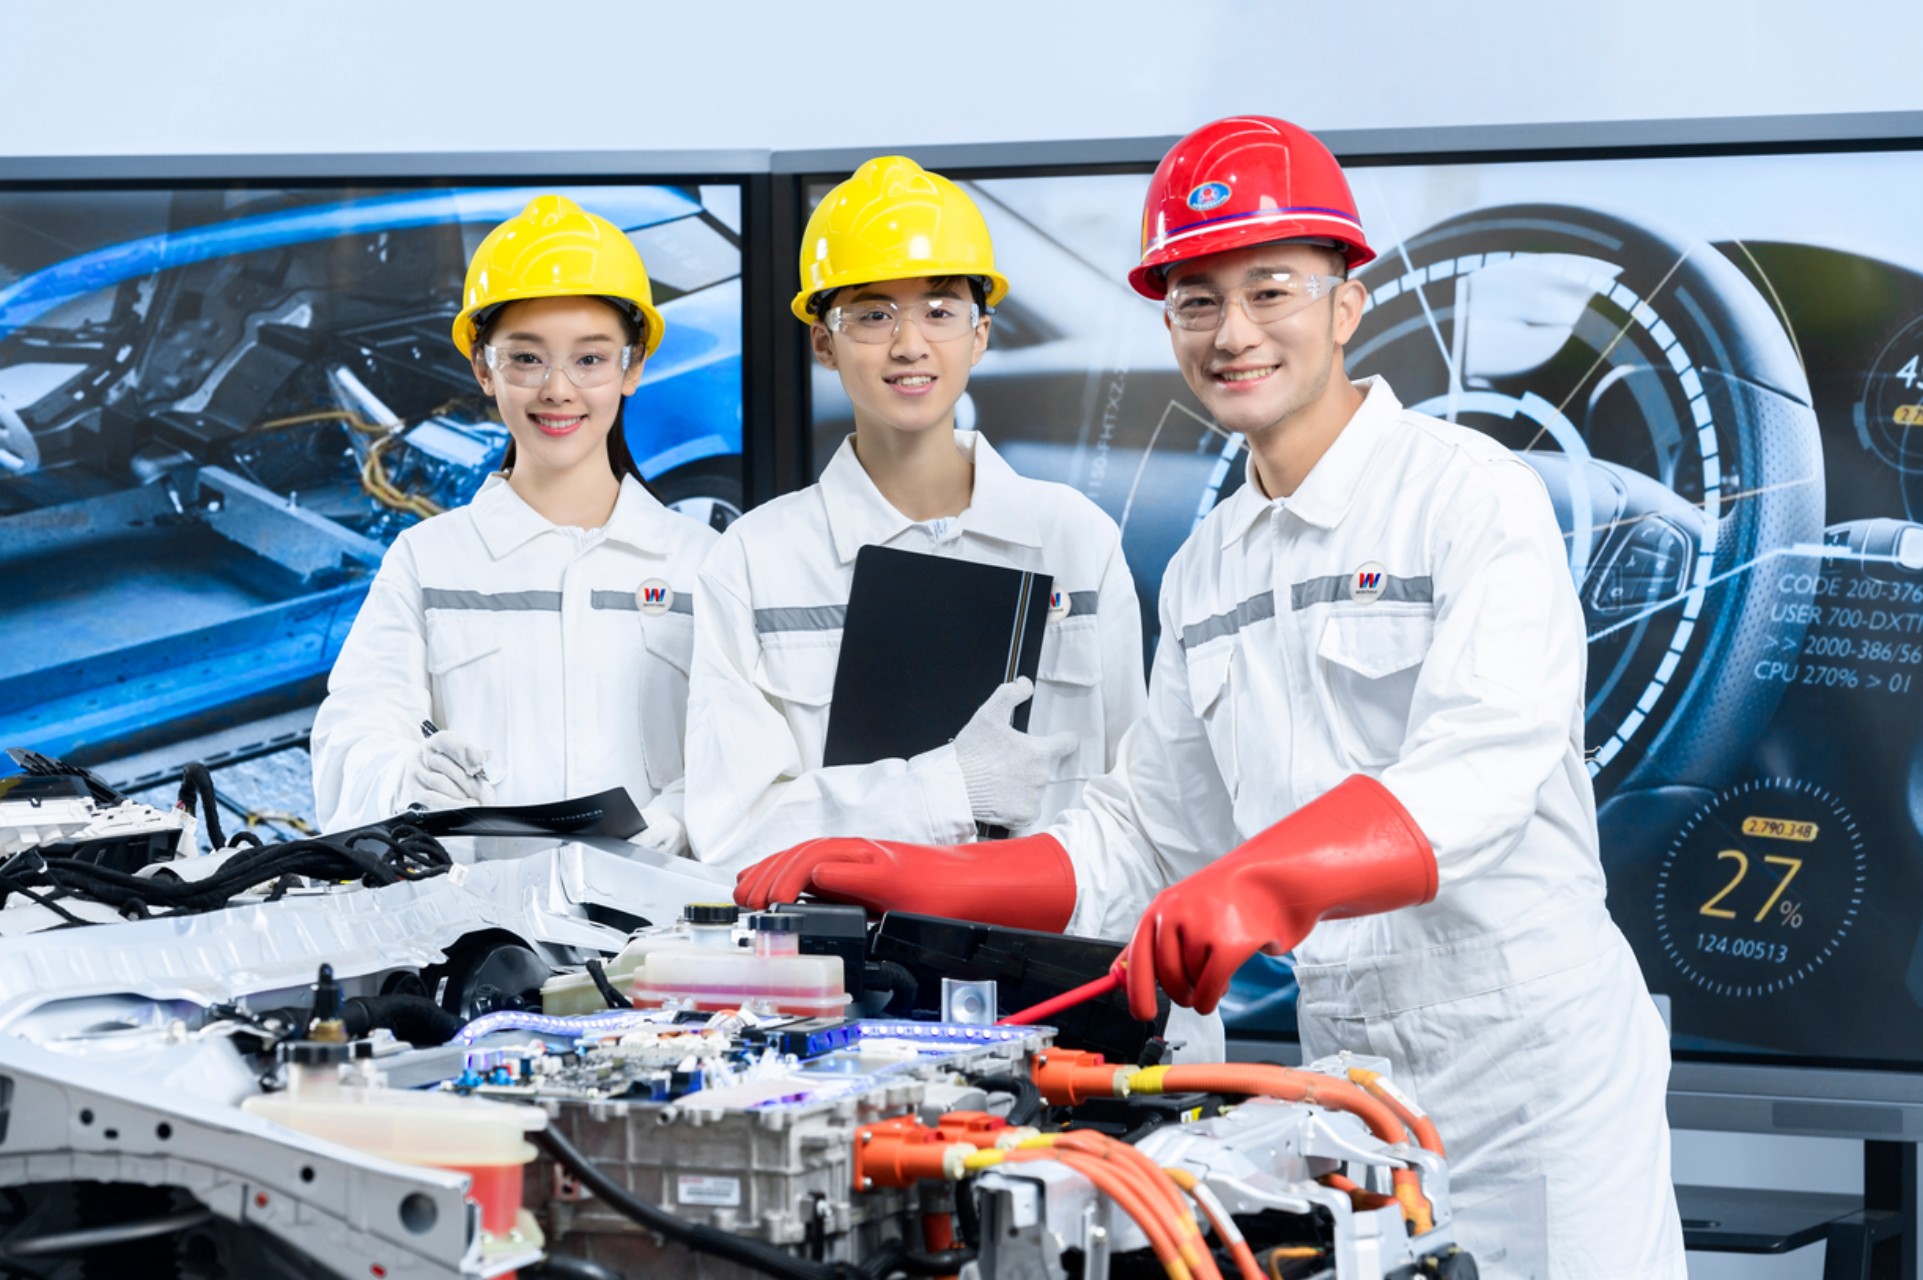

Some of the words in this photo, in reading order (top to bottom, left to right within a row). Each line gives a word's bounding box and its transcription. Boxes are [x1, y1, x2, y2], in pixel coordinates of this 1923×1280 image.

[1778, 573, 1842, 597] CODE
[1845, 578, 1923, 603] 200-376
[1770, 603, 1822, 625] USER
[1804, 635, 1922, 664] 2000-386/56
[1754, 660, 1799, 683] CPU
[1802, 665, 1858, 688] 270%
[1748, 819, 1813, 839] 2.790.348
[1696, 933, 1789, 963] 124.00513
